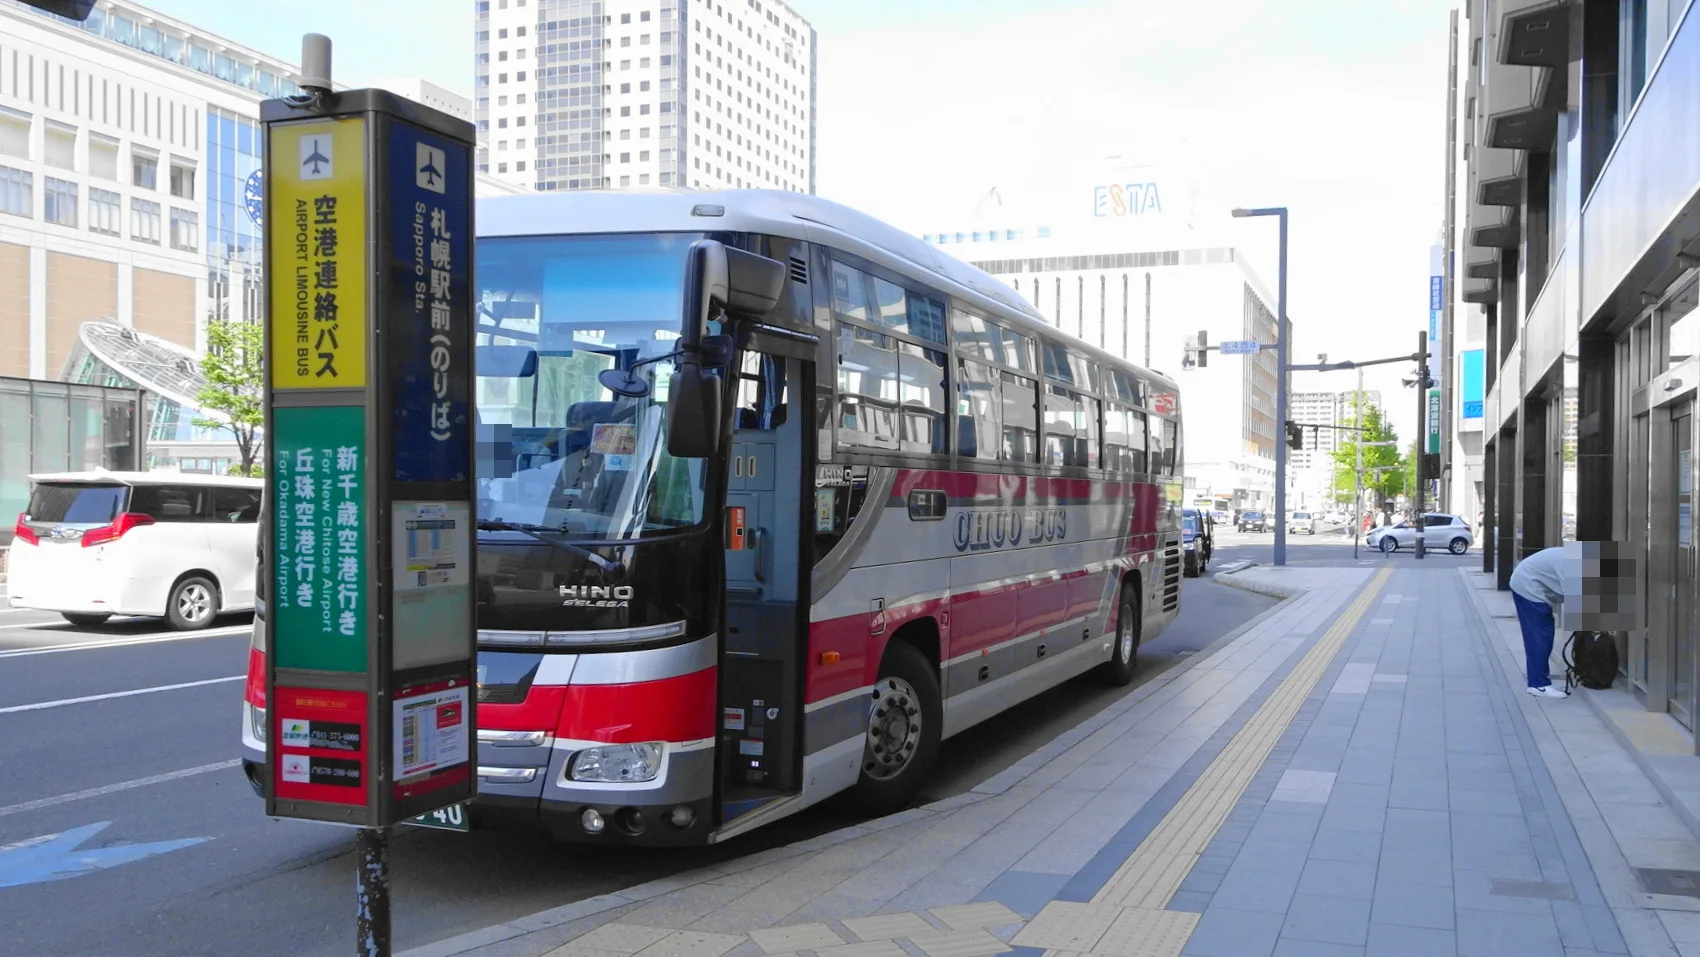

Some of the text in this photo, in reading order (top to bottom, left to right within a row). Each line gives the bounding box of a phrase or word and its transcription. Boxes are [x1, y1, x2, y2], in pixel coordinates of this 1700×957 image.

[414, 201, 427, 314] Sapporo Sta.
[1094, 182, 1161, 217] ESTA
[296, 199, 309, 377] AIRPORT LIMOUSINE BUS
[313, 194, 339, 379] 空港連絡バス
[278, 450, 290, 607] For Okadama Airport
[294, 447, 316, 608] 丘珠空港行き
[320, 449, 333, 632] For New Chitose Airport
[336, 445, 359, 636] 新千歳空港行き
[559, 585, 635, 600] HINO
[953, 508, 1067, 552] CHUO BUS
